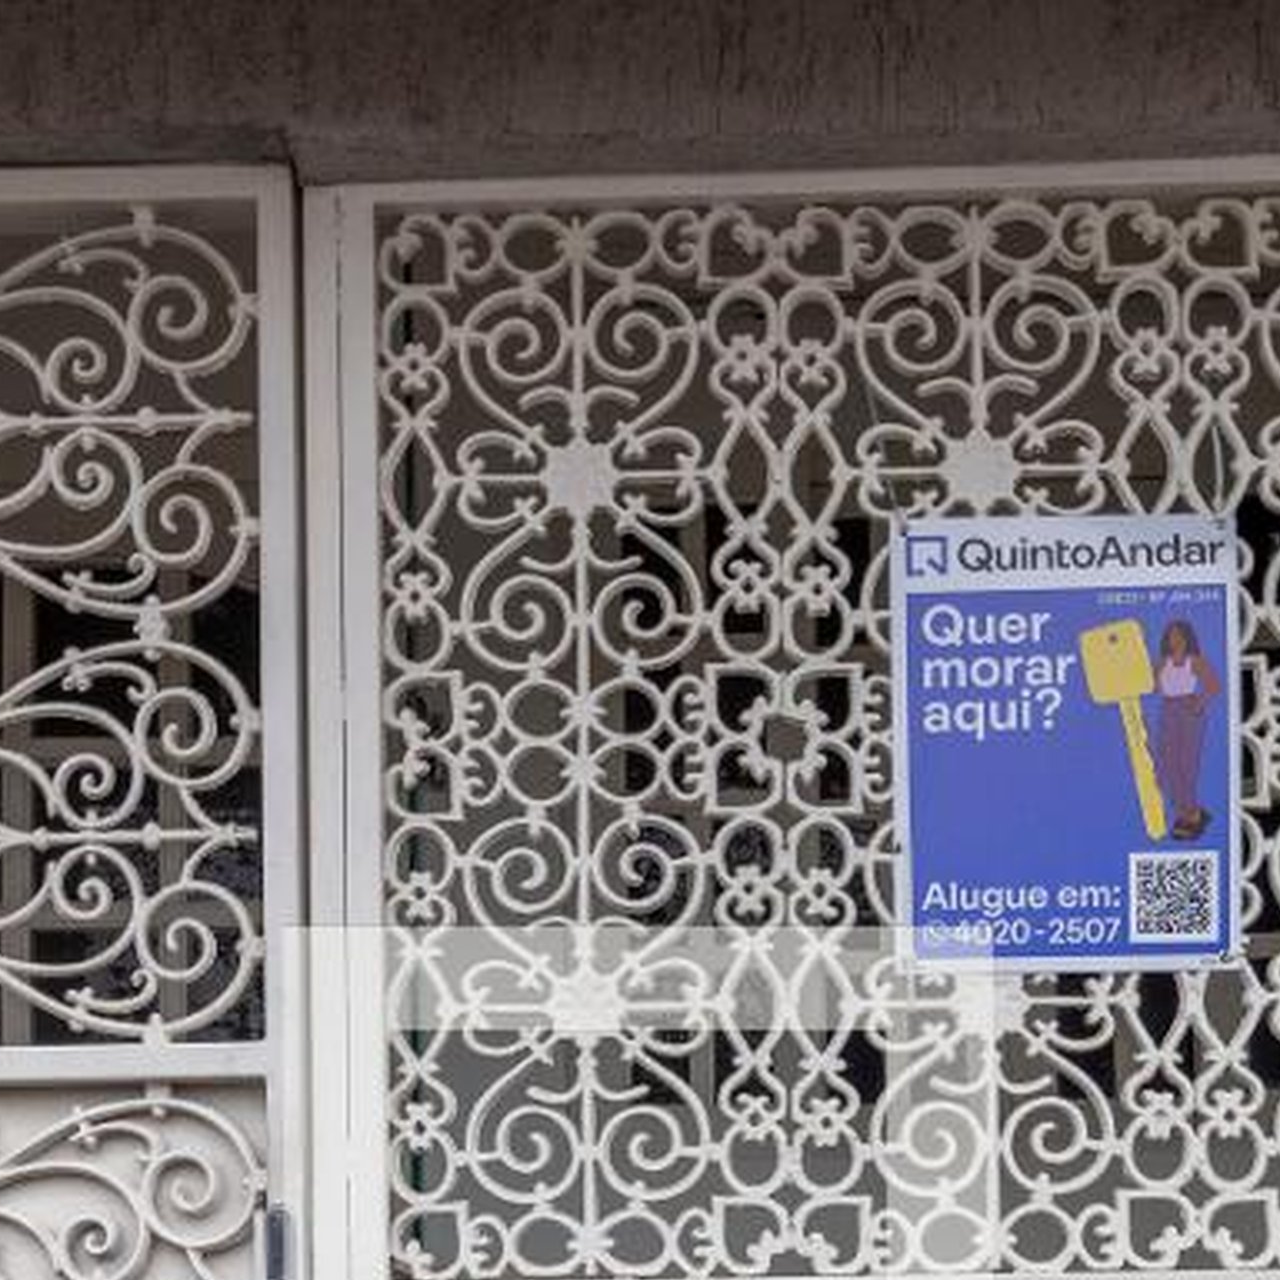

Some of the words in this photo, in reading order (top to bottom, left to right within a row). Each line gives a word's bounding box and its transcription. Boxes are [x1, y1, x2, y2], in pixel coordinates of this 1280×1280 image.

[956, 532, 1224, 573] QuintoAndar
[922, 604, 1050, 647] Quer
[922, 653, 1076, 688] morar
[922, 688, 1062, 739] aqui?
[921, 882, 1048, 917] Alugue
[1057, 884, 1121, 908] em:
[954, 917, 1121, 945] 4020-2507
